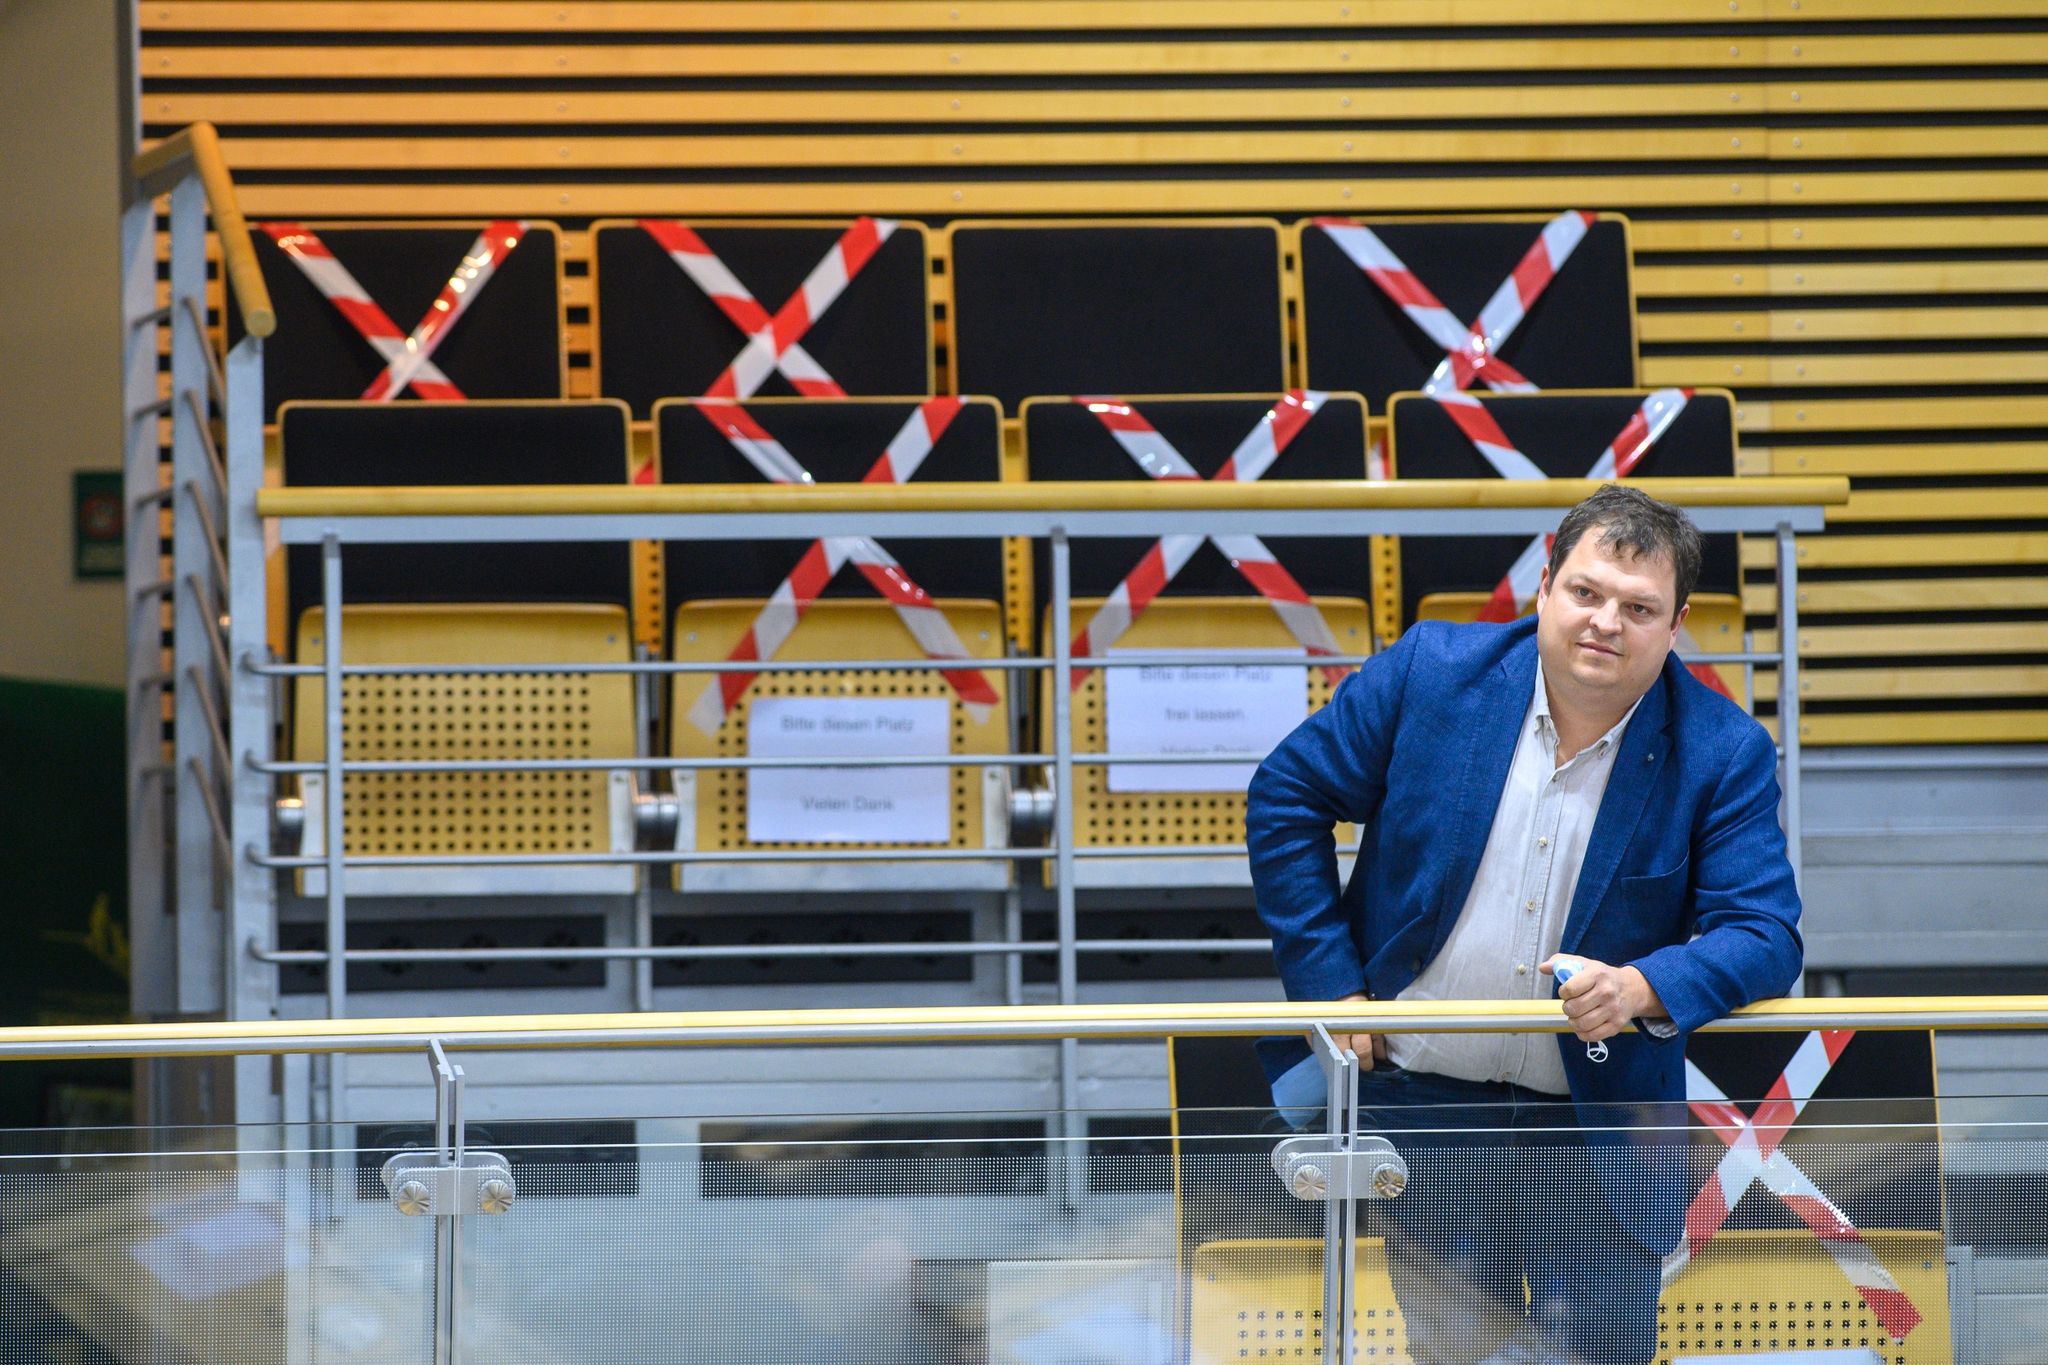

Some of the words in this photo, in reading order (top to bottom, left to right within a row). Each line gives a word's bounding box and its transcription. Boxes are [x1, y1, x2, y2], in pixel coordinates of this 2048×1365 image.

[781, 714, 815, 731] Bitte
[876, 714, 914, 731] Platz
[803, 796, 848, 812] Vielen
